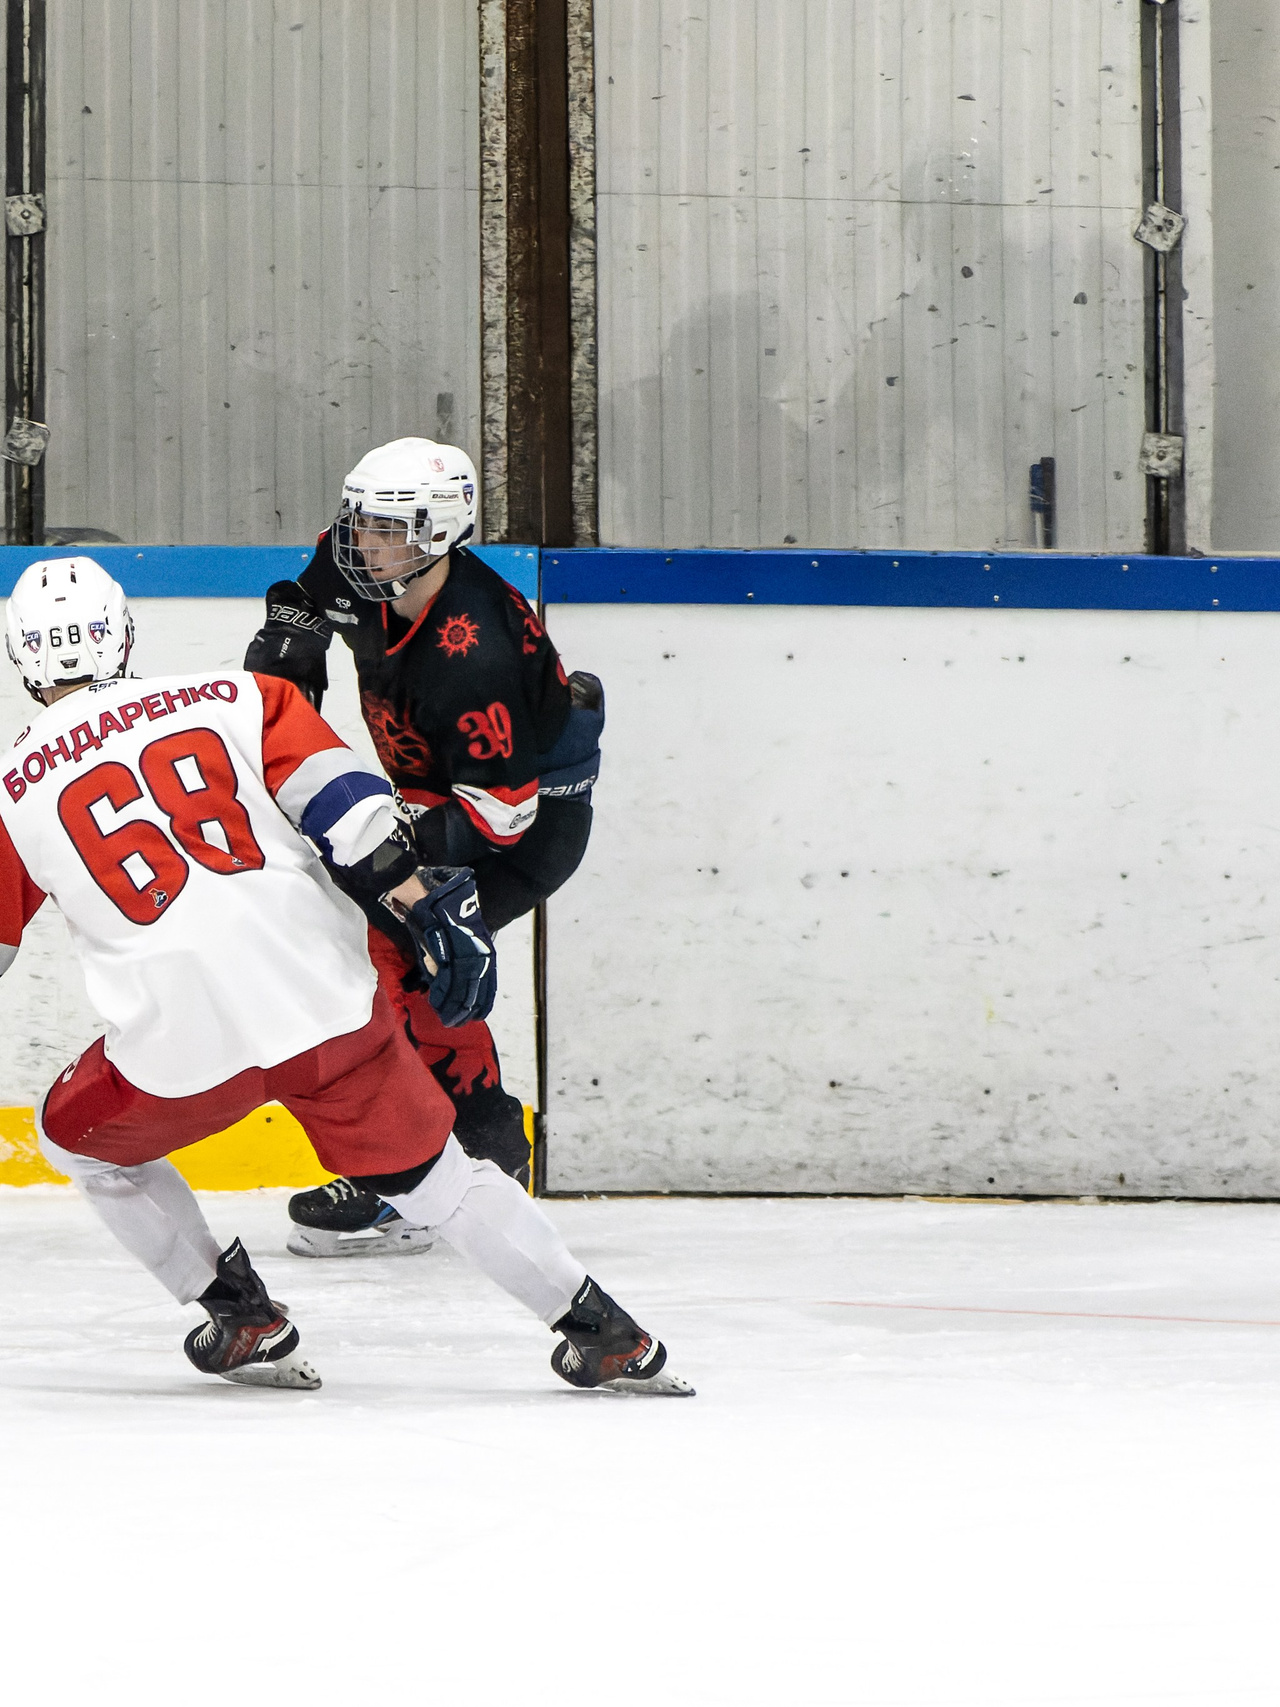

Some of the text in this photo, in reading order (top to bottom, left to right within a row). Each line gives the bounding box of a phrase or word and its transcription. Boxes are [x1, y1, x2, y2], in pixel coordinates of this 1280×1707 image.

[49, 624, 81, 648] 68
[2, 679, 238, 804] БОНДАРЕНКО
[456, 701, 513, 761] 39
[57, 726, 266, 926] 68
